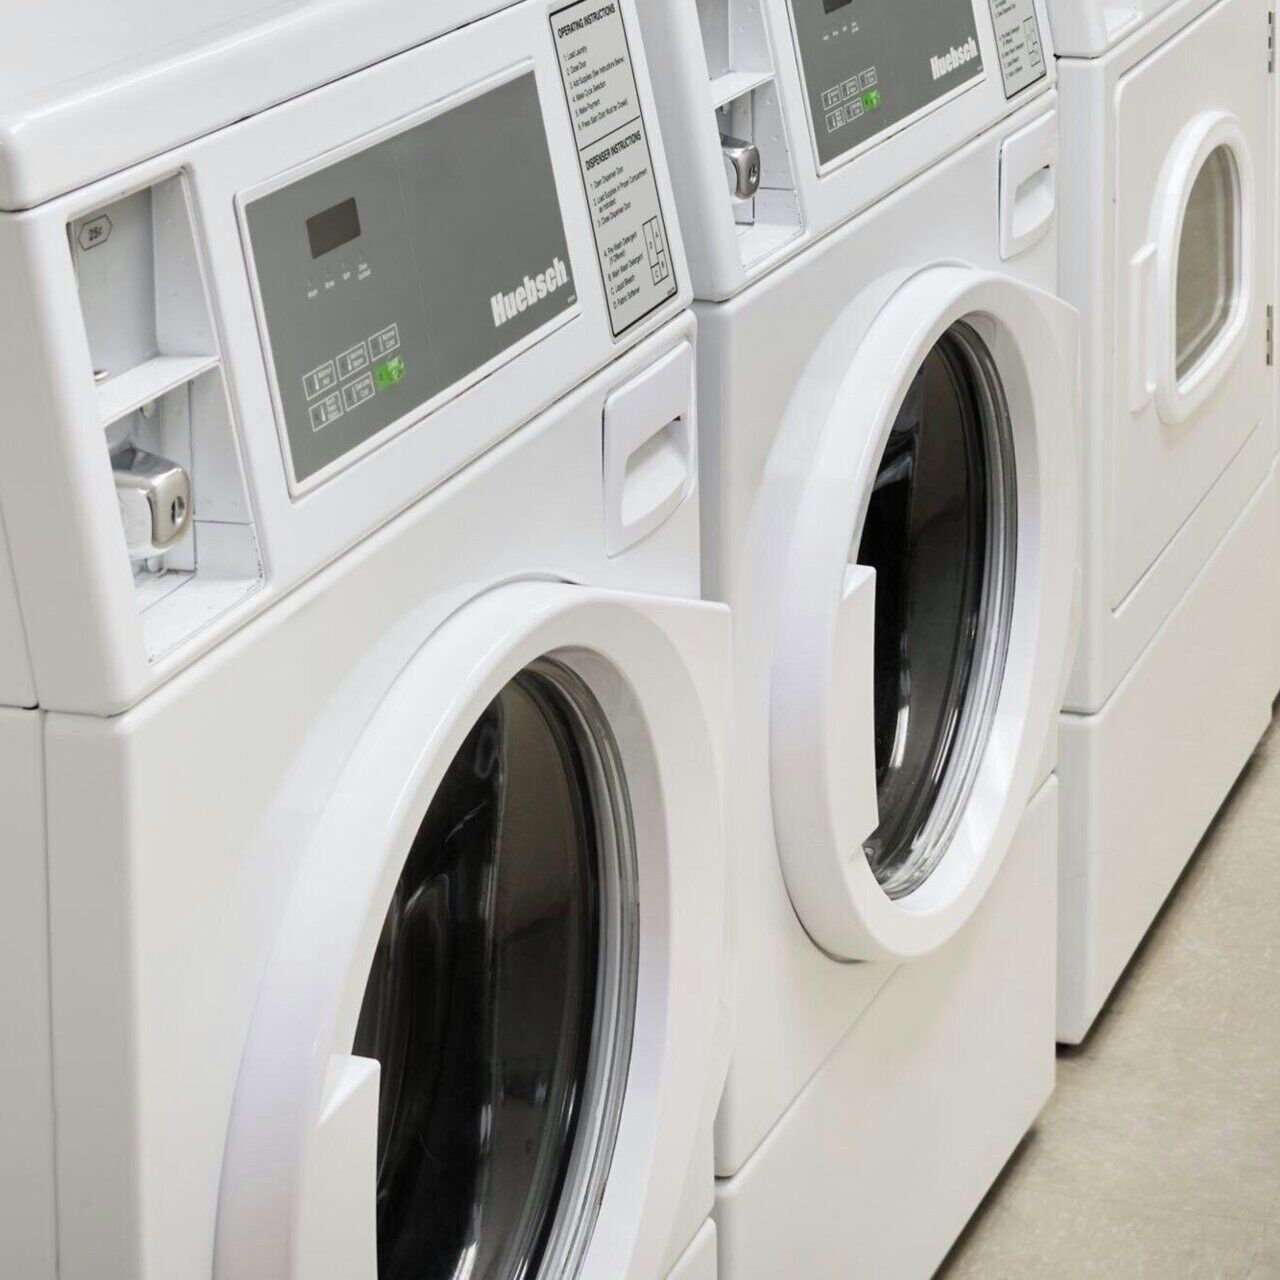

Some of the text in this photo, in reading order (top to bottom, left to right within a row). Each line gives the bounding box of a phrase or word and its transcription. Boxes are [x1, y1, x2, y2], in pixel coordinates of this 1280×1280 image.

[557, 4, 616, 39] OPERATING INSTRUCTIONS
[930, 36, 978, 80] Huebsch
[585, 130, 642, 171] DISPENSER INSTRUCTIONS
[490, 257, 568, 328] Huebsch
